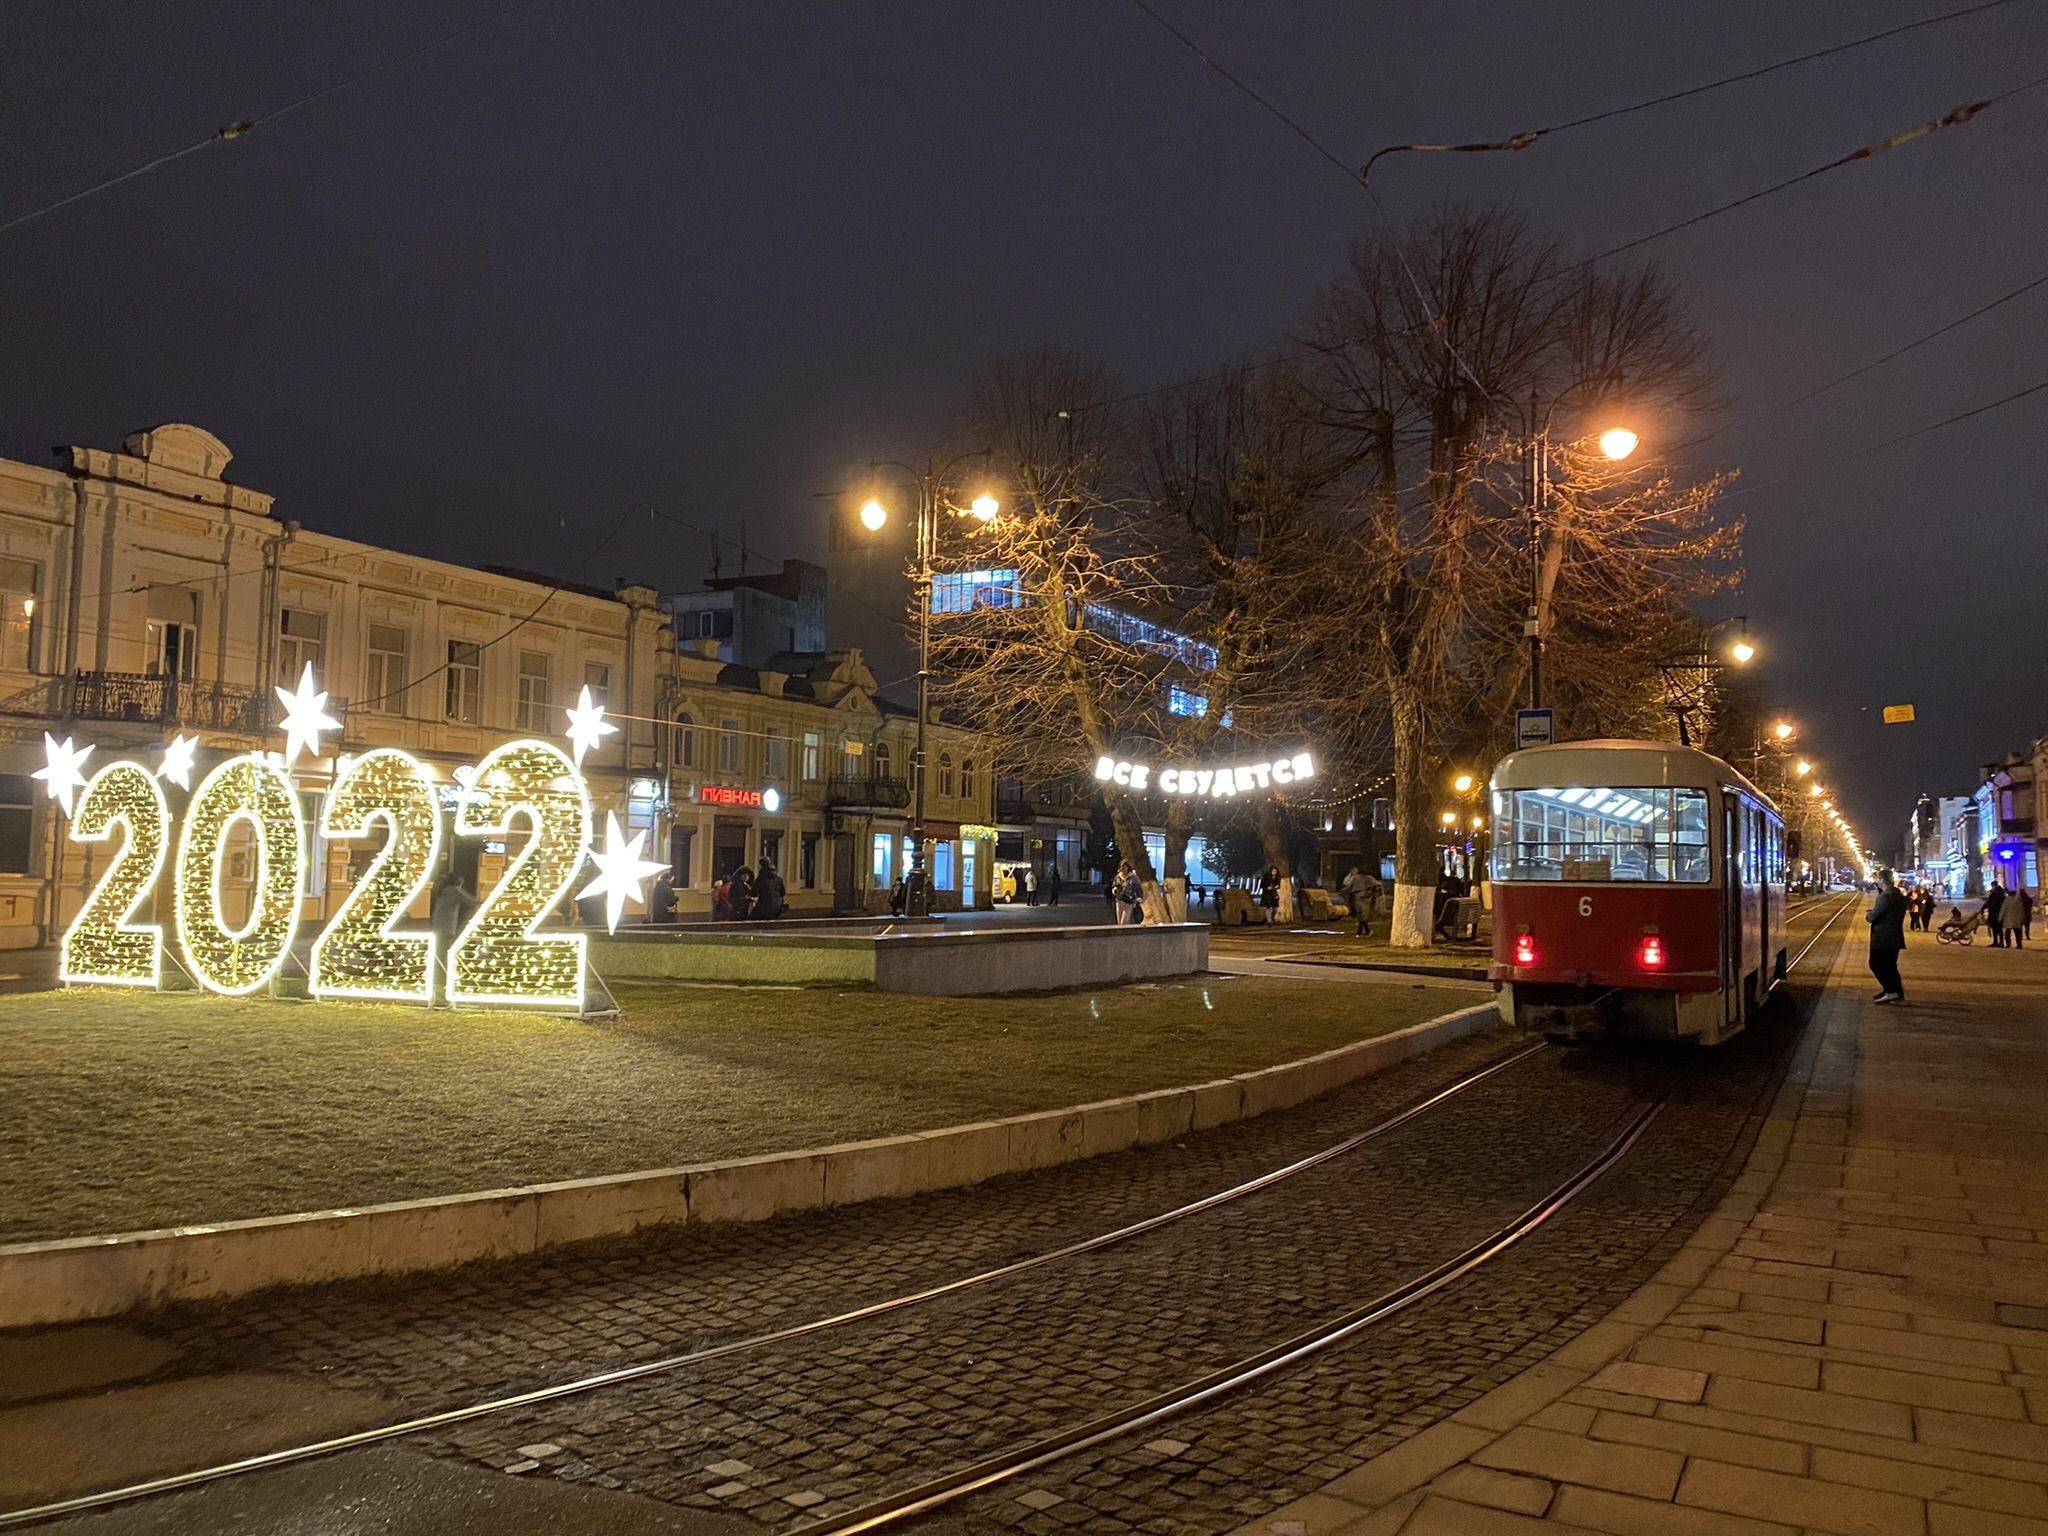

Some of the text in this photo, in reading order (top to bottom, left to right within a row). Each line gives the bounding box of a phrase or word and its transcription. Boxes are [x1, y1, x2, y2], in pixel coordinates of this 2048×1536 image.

[1096, 753, 1314, 797] ВСЕ СБУДЕТСЯ
[702, 788, 761, 805] ПИВНАЯ
[60, 739, 590, 1006] 2022
[1579, 896, 1592, 917] 6
